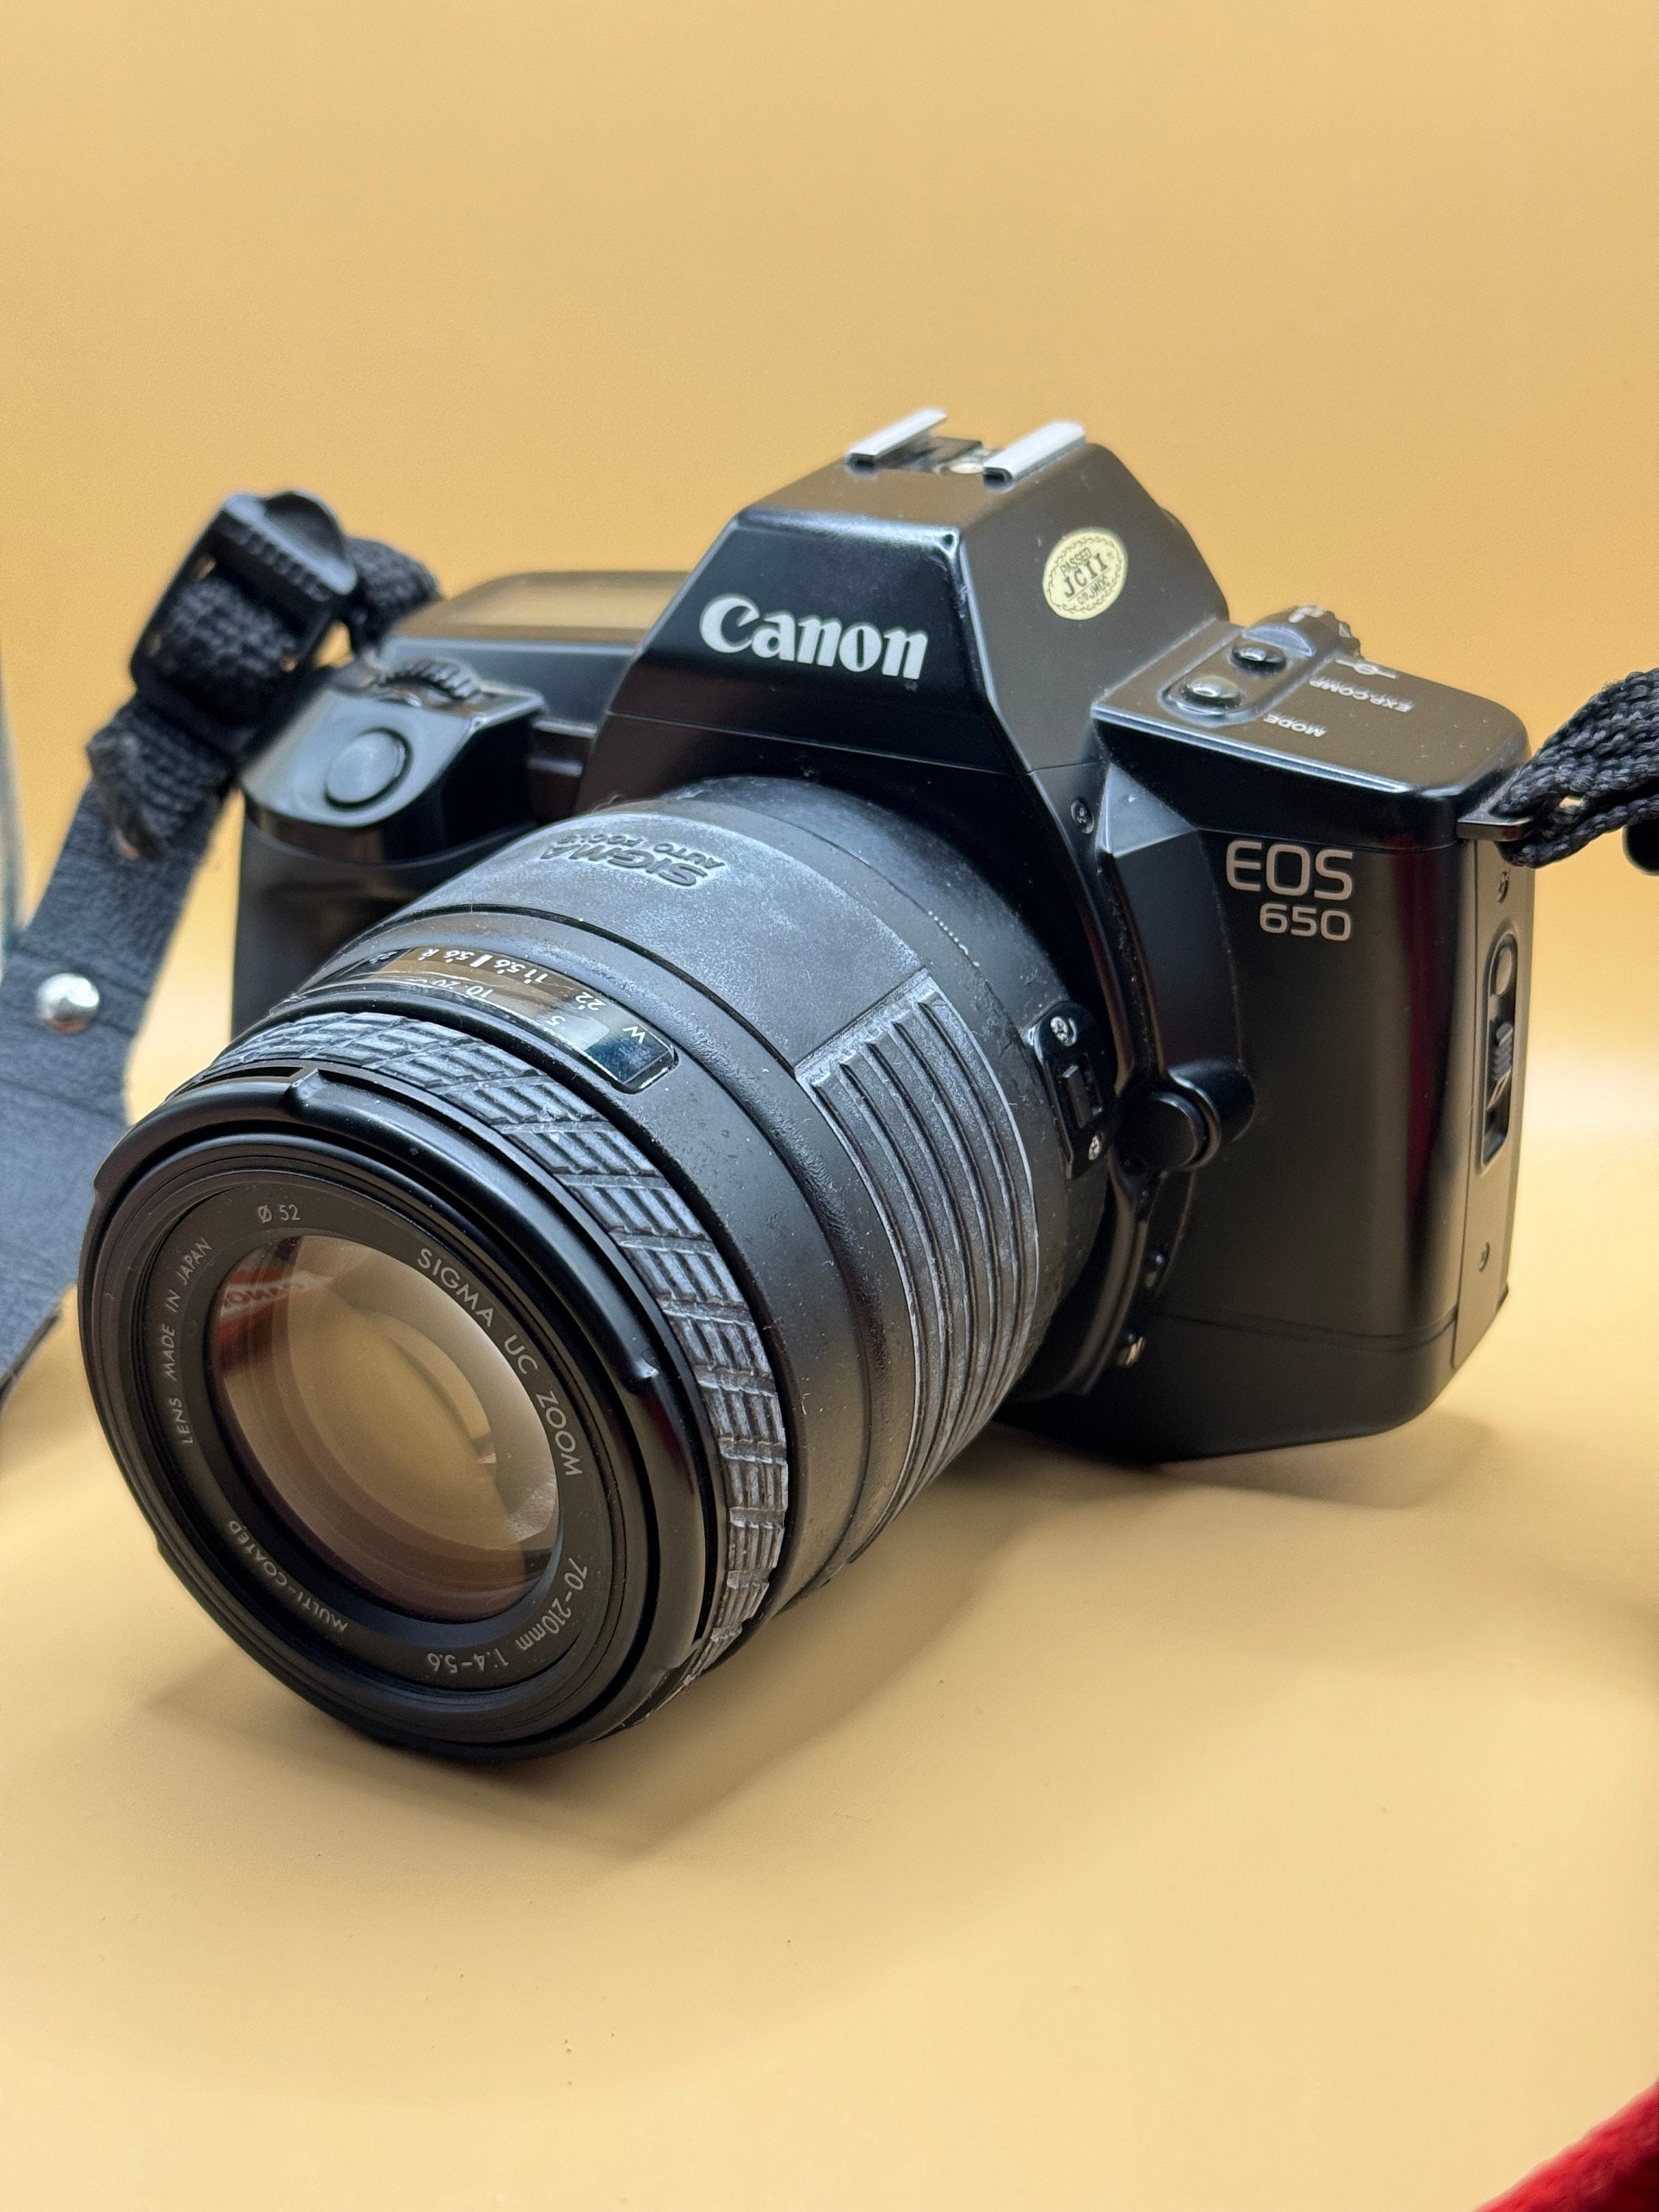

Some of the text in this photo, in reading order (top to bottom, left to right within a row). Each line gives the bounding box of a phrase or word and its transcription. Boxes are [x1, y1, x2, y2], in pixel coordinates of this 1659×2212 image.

[1060, 547, 1093, 577] PASSED
[1063, 553, 1107, 599] JCII
[700, 595, 929, 680] Canon
[1263, 713, 1327, 737] MODE
[540, 844, 709, 887] SIGMA
[653, 843, 726, 869] AUTO
[1225, 840, 1355, 901] EOS
[1259, 903, 1352, 942] 650
[465, 985, 493, 998] 10
[524, 969, 549, 983] 11
[546, 1015, 566, 1026] 5
[575, 991, 605, 1011] 22
[279, 1203, 301, 1221] 52
[417, 1247, 494, 1328] SIGMA
[161, 1237, 213, 1444] LENS MADE IN JAPAN
[504, 1335, 538, 1374] UC
[535, 1390, 583, 1475] ZOOM
[229, 1520, 349, 1632] MULTI-COATED
[515, 1557, 588, 1650] 70-210mm
